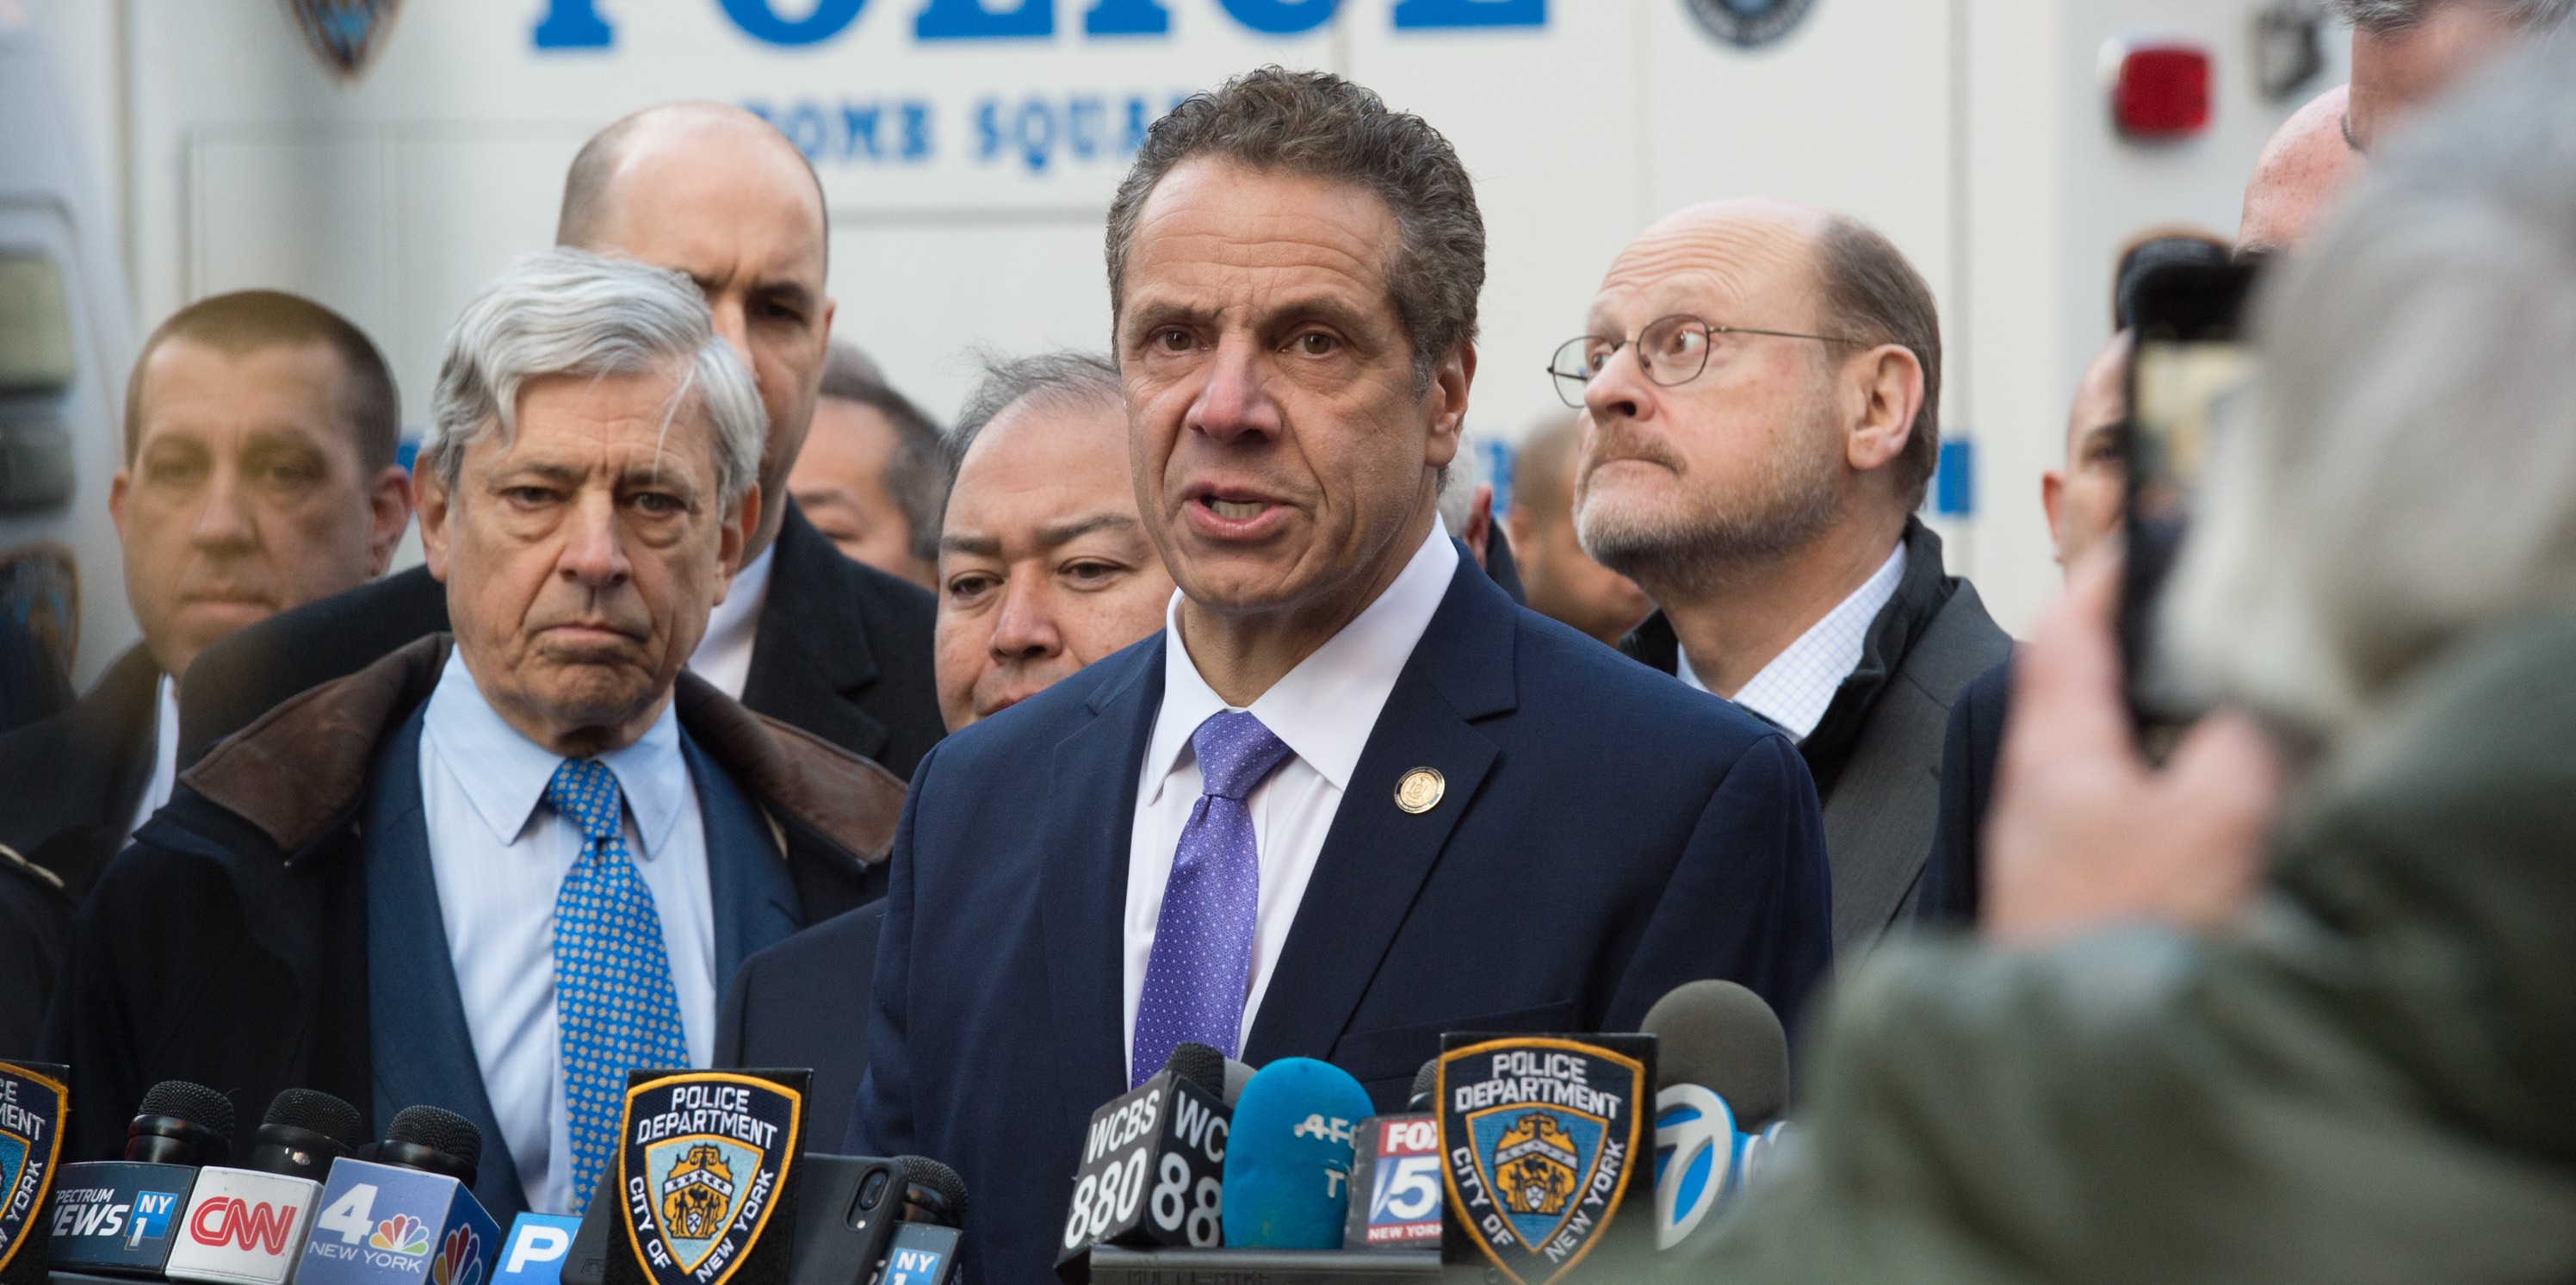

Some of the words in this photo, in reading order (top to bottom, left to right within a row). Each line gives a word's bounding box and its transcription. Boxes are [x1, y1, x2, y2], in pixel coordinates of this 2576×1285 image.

[971, 96, 1188, 172] SQUA
[1492, 1051, 1588, 1084] POLICE
[672, 1086, 750, 1113] POLICE
[1454, 1077, 1622, 1119] DEPARTMENT
[636, 1110, 777, 1149] DEPARTMENT
[1088, 1089, 1160, 1164] WCBS
[1175, 1089, 1229, 1163] WC
[6, 1160, 43, 1222] YORK
[56, 1189, 115, 1203] PECTRUM
[139, 1195, 173, 1214] NY
[1064, 1146, 1147, 1249] 880
[1151, 1152, 1223, 1248] 88
[1324, 1168, 1346, 1198] T
[1388, 1155, 1441, 1220] 5
[1452, 1146, 1490, 1207] CITY
[1482, 1214, 1515, 1245] OF
[1544, 1209, 1593, 1263] NEW
[1583, 1137, 1625, 1206] YORK
[130, 1217, 147, 1247] 1
[190, 1196, 297, 1255] CNN
[318, 1183, 378, 1245] 4
[629, 1176, 654, 1232] CITY
[647, 1238, 672, 1269] OF
[695, 1238, 734, 1283] NEW
[734, 1169, 774, 1232] YORK
[1368, 1226, 1403, 1240] NEW
[308, 1241, 358, 1262] NEW
[363, 1250, 423, 1273] YORK
[505, 1225, 578, 1273] P
[896, 1251, 935, 1273] NY
